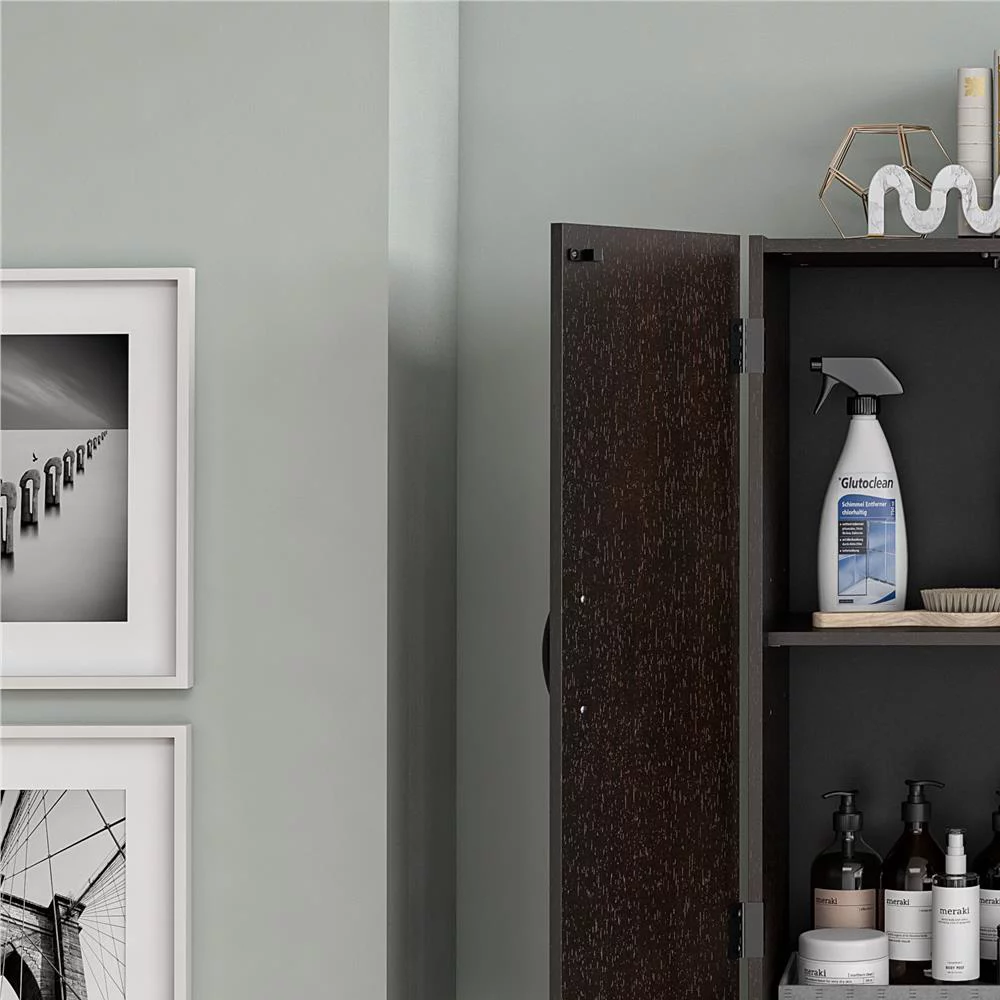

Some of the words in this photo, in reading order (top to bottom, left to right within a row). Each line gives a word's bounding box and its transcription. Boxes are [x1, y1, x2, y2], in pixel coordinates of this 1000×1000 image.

[840, 476, 894, 489] Glutoclean
[886, 898, 910, 906] meraki
[939, 906, 970, 915] meraki
